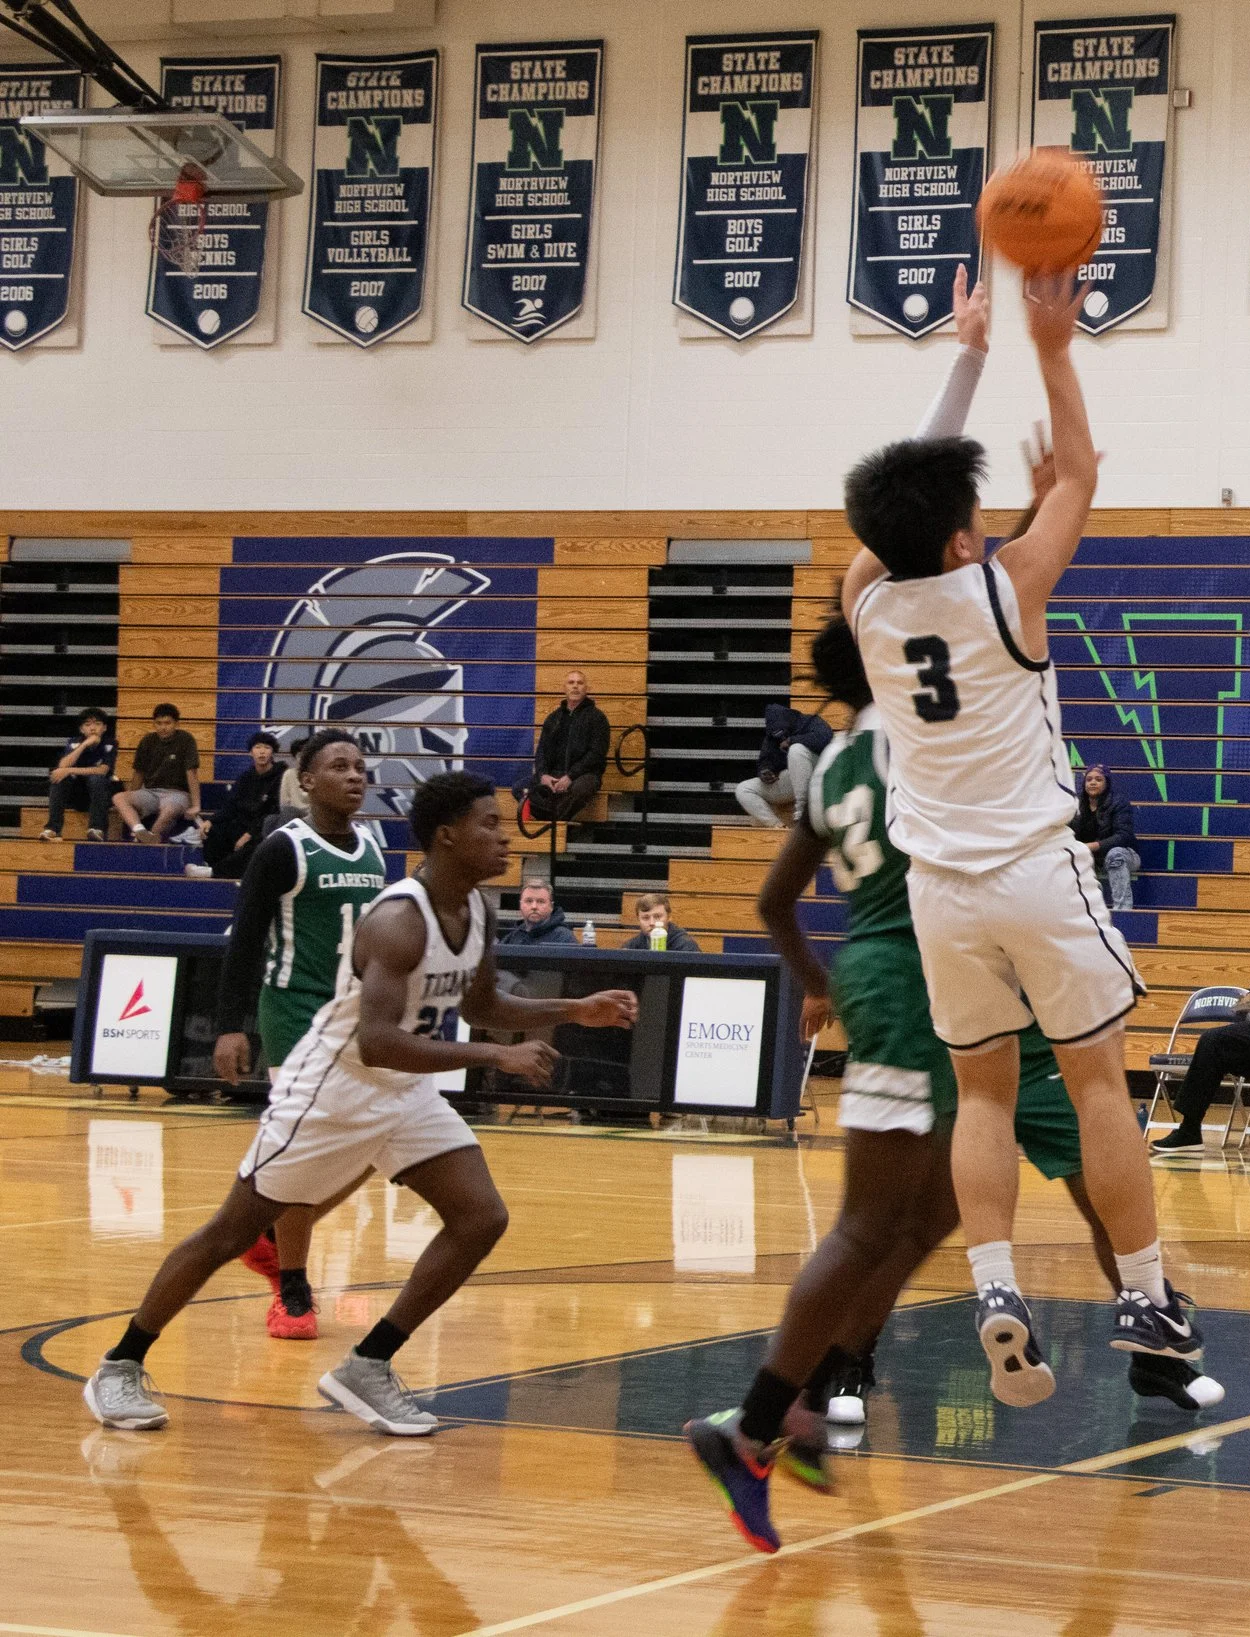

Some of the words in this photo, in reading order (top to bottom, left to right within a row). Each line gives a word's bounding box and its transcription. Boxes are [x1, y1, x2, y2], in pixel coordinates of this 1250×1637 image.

[894, 45, 954, 65] STATE
[1072, 36, 1135, 58] STATE
[722, 51, 781, 72] STATE
[510, 60, 567, 80] STATE
[869, 66, 979, 90] CHAMPIONS
[1047, 58, 1160, 83] CHAMPIONS
[192, 75, 246, 92] STATE
[347, 70, 402, 88] STATE
[698, 72, 803, 95] CHAMPIONS
[326, 89, 425, 110] CHAMPIONS
[486, 81, 589, 102] CHAMPIONS
[0, 100, 73, 119] AMPIONS
[172, 95, 267, 113] CHAMPIONS
[891, 94, 954, 160] N
[1069, 86, 1135, 154] N
[505, 108, 566, 171] N
[717, 100, 779, 165] N
[345, 115, 403, 178] N
[710, 170, 782, 185] NORTHVIEW
[884, 165, 958, 181] NORTHVIEW
[339, 183, 404, 198] NORTHVIEW
[499, 177, 568, 191] NORTHVIEW
[879, 183, 909, 198] HIGH
[913, 181, 960, 196] SCHOOL
[1093, 175, 1142, 190] SCHOOL
[0, 192, 53, 205] ORTHVIEW
[495, 194, 523, 207] HIGH
[527, 192, 571, 206] SCHOOL
[706, 188, 736, 202] HIGH
[740, 186, 786, 200] SCHOOL
[15, 207, 55, 220] SCHOOL
[208, 203, 251, 216] SCHOOL
[334, 200, 361, 214] HIGH
[364, 199, 409, 213] SCHOOL
[898, 215, 941, 231] GIRLS
[1101, 209, 1117, 225] YS
[511, 224, 552, 240] GIRLS
[727, 219, 763, 235] BOYS
[1100, 227, 1126, 243] NIS
[1, 237, 39, 252] GIRLS
[197, 234, 229, 249] BOYS
[350, 230, 390, 245] GIRLS
[726, 237, 762, 253] GOLF
[900, 233, 937, 249] GOLF
[327, 247, 411, 263] VOLLEYBALL
[487, 243, 525, 259] SWIM
[530, 245, 540, 258] &
[544, 242, 577, 258] DIVE
[3, 253, 35, 269] GOLF
[191, 251, 236, 267] TENNIS
[724, 271, 761, 288] 2007
[898, 267, 935, 284] 2007
[1077, 263, 1116, 281] 2007
[193, 283, 228, 299] 2006
[350, 281, 385, 297] 2007
[512, 275, 547, 291] 2007
[0, 286, 34, 302] 2006
[902, 634, 961, 723] 3
[318, 873, 385, 889] CLARKSTO
[1194, 996, 1239, 1010] NORTHVI
[103, 1028, 125, 1038] BSN
[126, 1029, 161, 1040] SPORTS
[688, 1022, 755, 1041] EMORY
